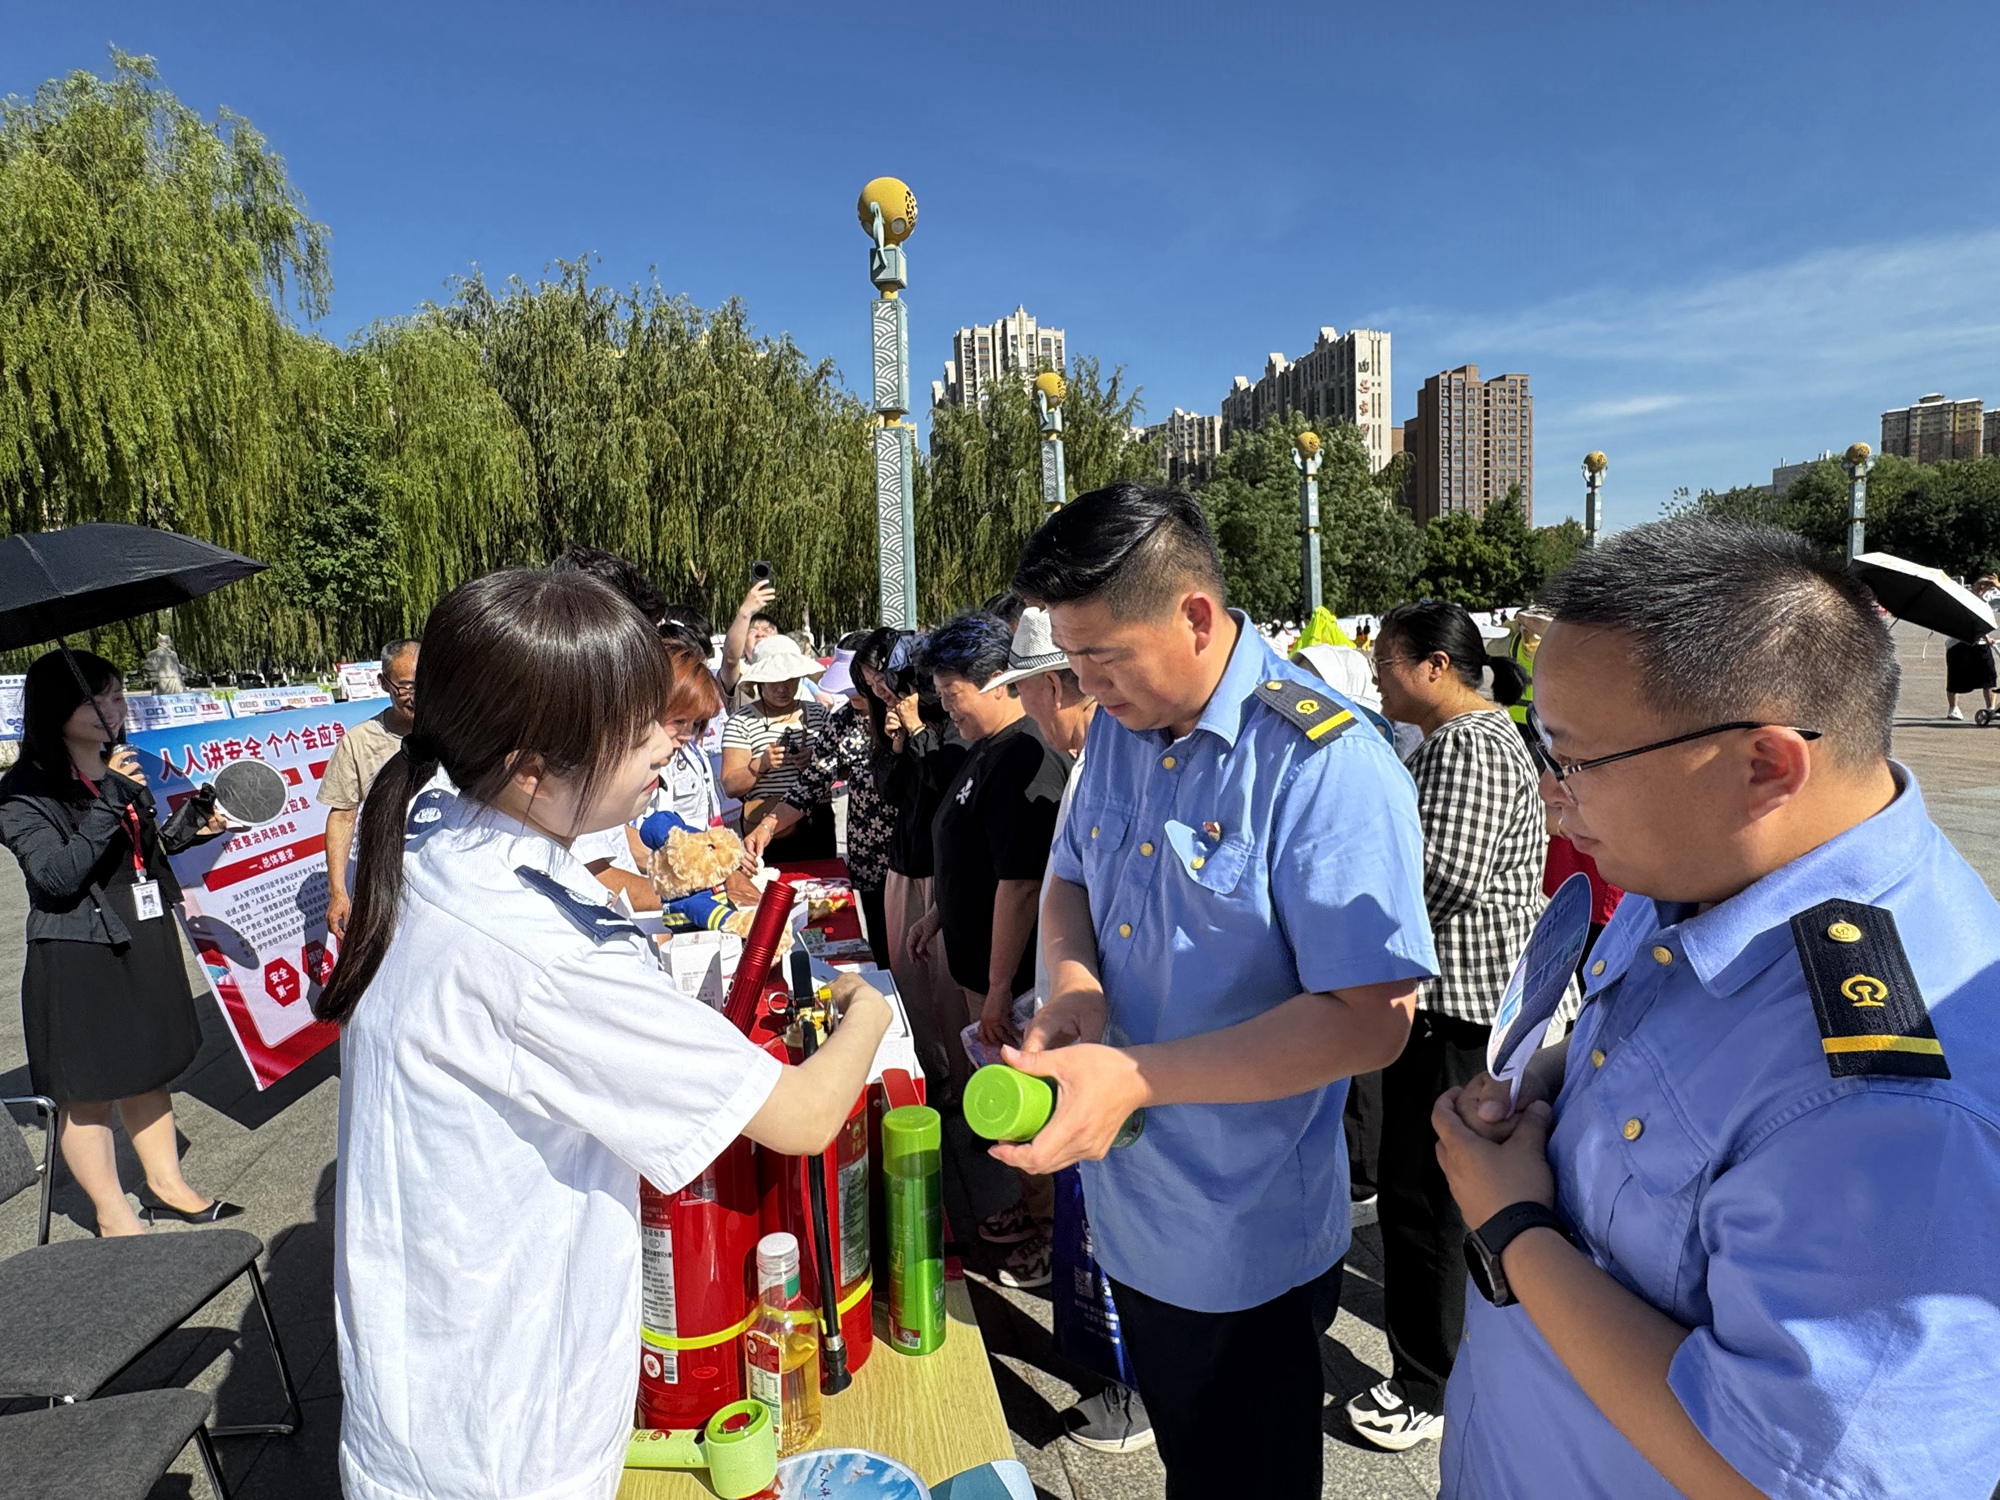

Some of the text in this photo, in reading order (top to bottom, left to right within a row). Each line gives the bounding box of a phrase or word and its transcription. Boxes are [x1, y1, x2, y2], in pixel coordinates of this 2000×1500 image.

[160, 721, 346, 782] 人人讲安全 个个会应急
[221, 820, 298, 855] 排查整治风险隐患
[248, 847, 296, 871] 一、总体要求
[232, 861, 327, 902] 深入学习贯彻习近平总书记关于安全生产的
[268, 966, 290, 986] 安全
[275, 982, 295, 998] 第一
